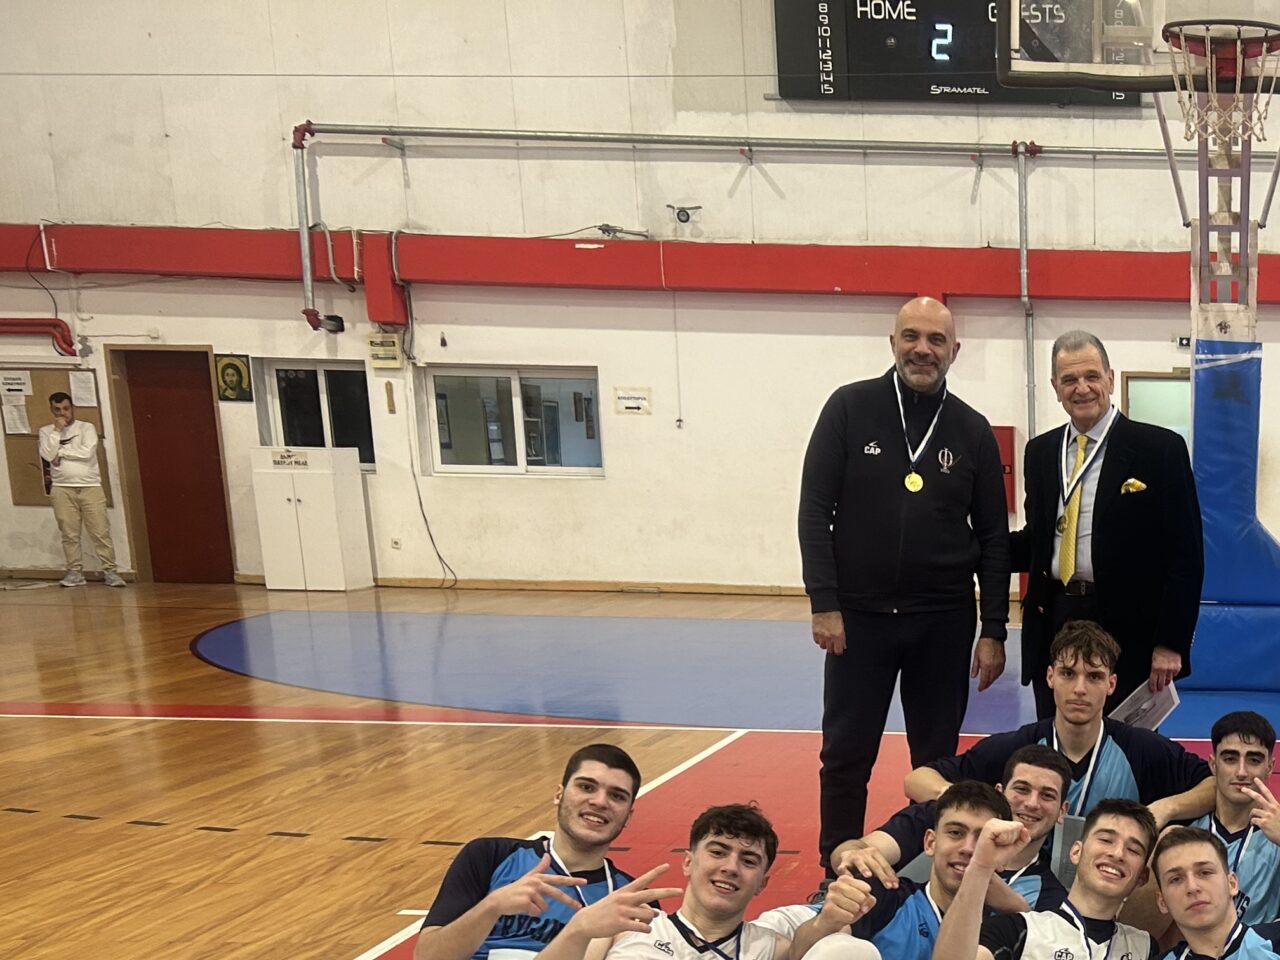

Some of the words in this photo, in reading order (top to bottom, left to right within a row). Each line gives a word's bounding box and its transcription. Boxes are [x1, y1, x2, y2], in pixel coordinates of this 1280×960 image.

[818, 3, 828, 13] 8
[856, 0, 917, 20] HOME
[988, 3, 1066, 24] GESTS
[819, 14, 829, 25] 9
[818, 26, 831, 37] 10
[931, 23, 953, 61] 2
[818, 49, 832, 60] 12
[820, 61, 833, 71] 13
[820, 72, 834, 83] 14
[820, 83, 834, 94] 15
[863, 445, 882, 456] CAP
